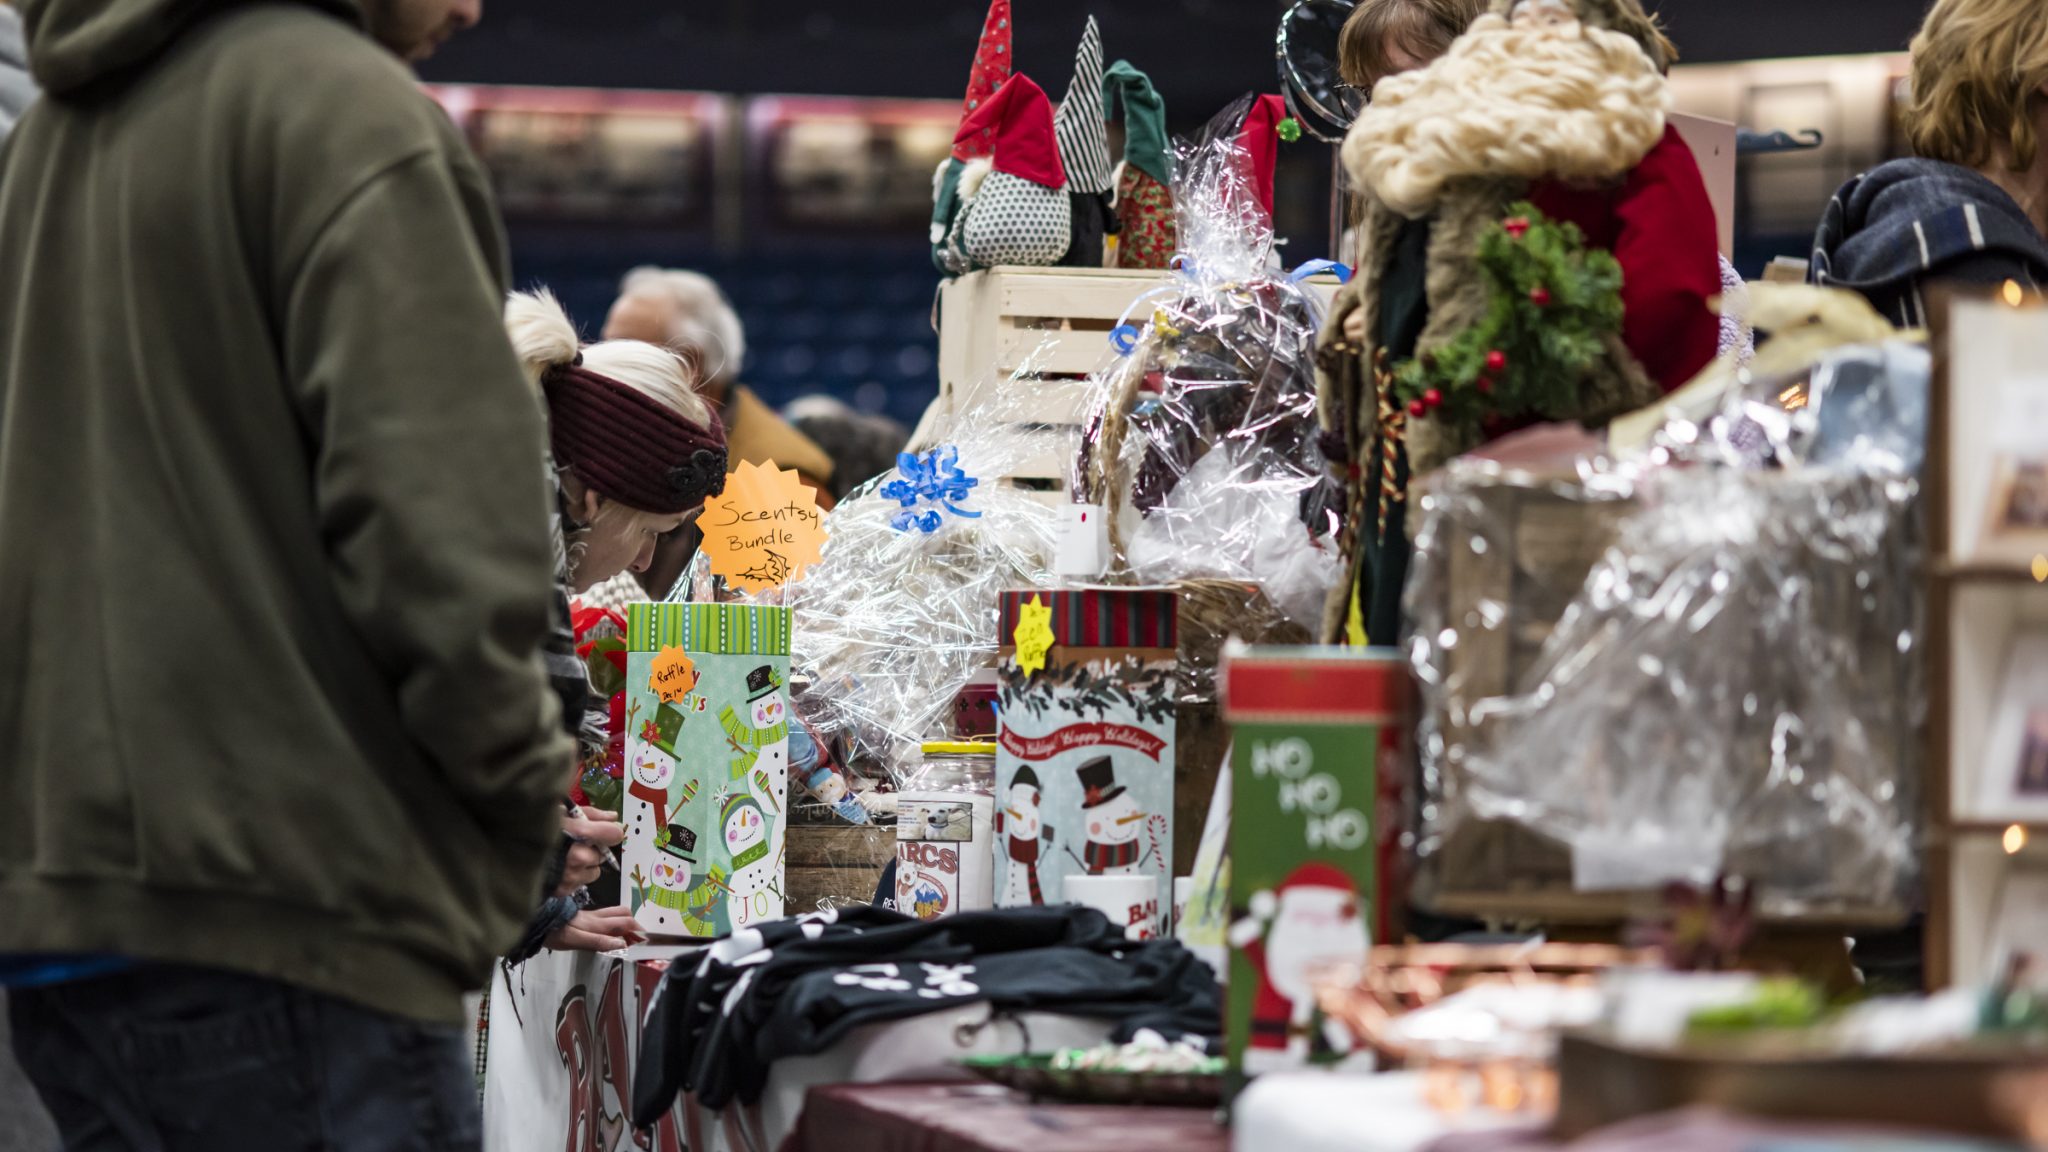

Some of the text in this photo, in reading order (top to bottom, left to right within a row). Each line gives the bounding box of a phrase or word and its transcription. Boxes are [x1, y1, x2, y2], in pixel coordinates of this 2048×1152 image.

[714, 500, 818, 531] Scentsy
[726, 528, 795, 551] Bundle
[657, 661, 685, 684] Raffle
[1060, 729, 1102, 747] Happy
[1250, 737, 1314, 780] HO
[1279, 772, 1342, 815] HO
[1305, 808, 1369, 851] HO
